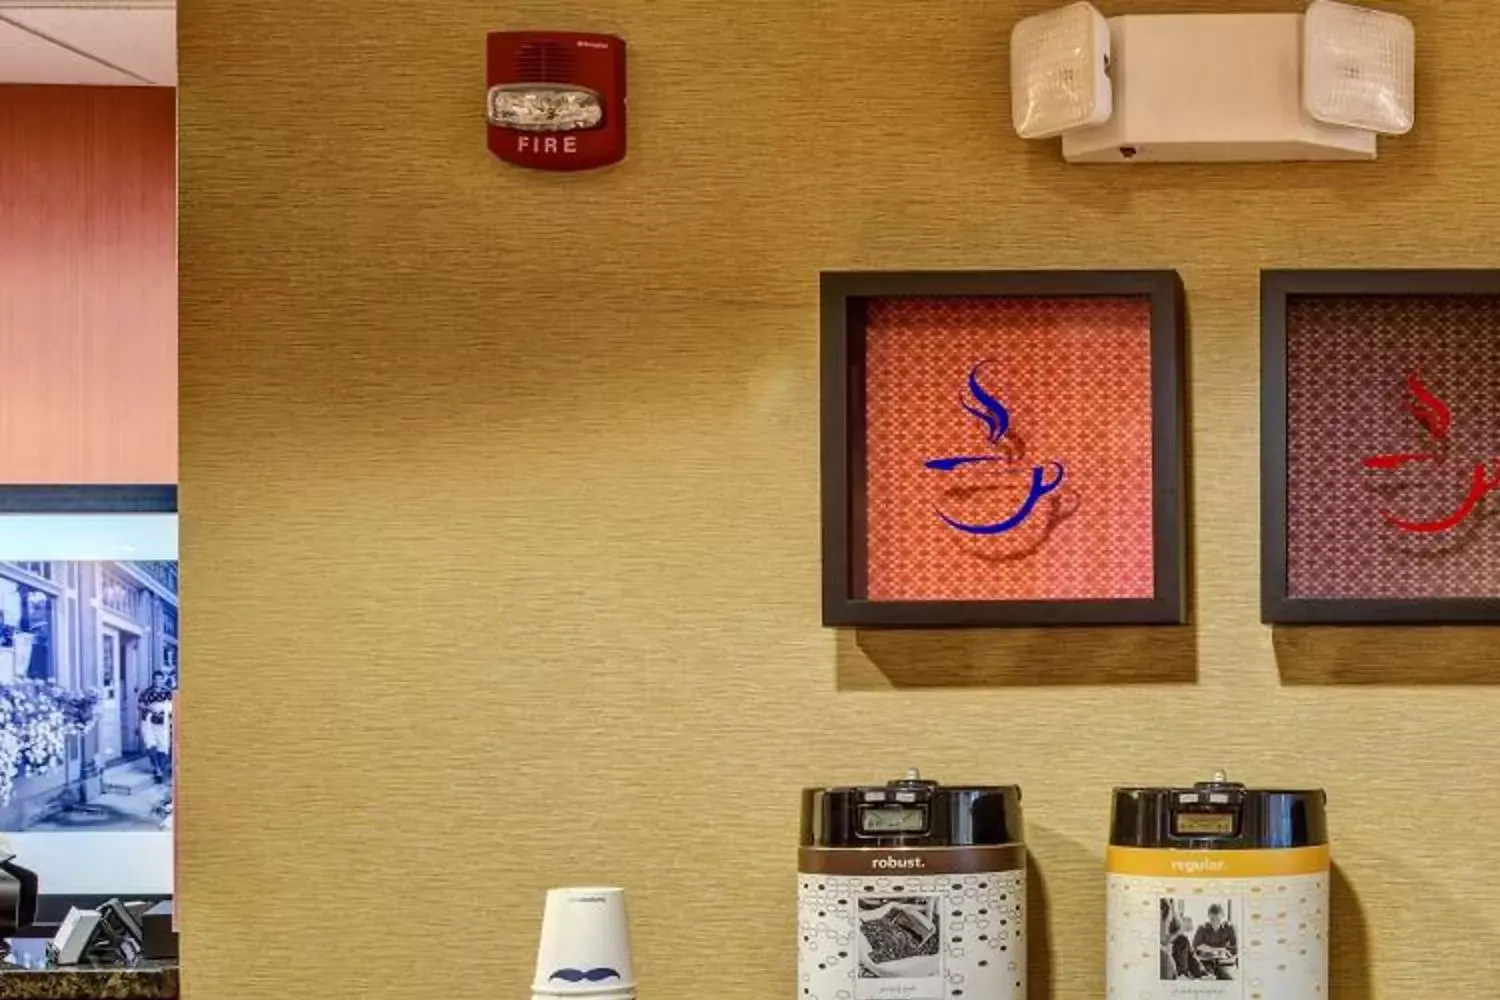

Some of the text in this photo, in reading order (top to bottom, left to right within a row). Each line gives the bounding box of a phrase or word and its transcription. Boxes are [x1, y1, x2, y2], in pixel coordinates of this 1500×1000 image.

[517, 136, 577, 153] FIRE
[872, 857, 925, 868] robust.
[1171, 859, 1228, 873] regular.
